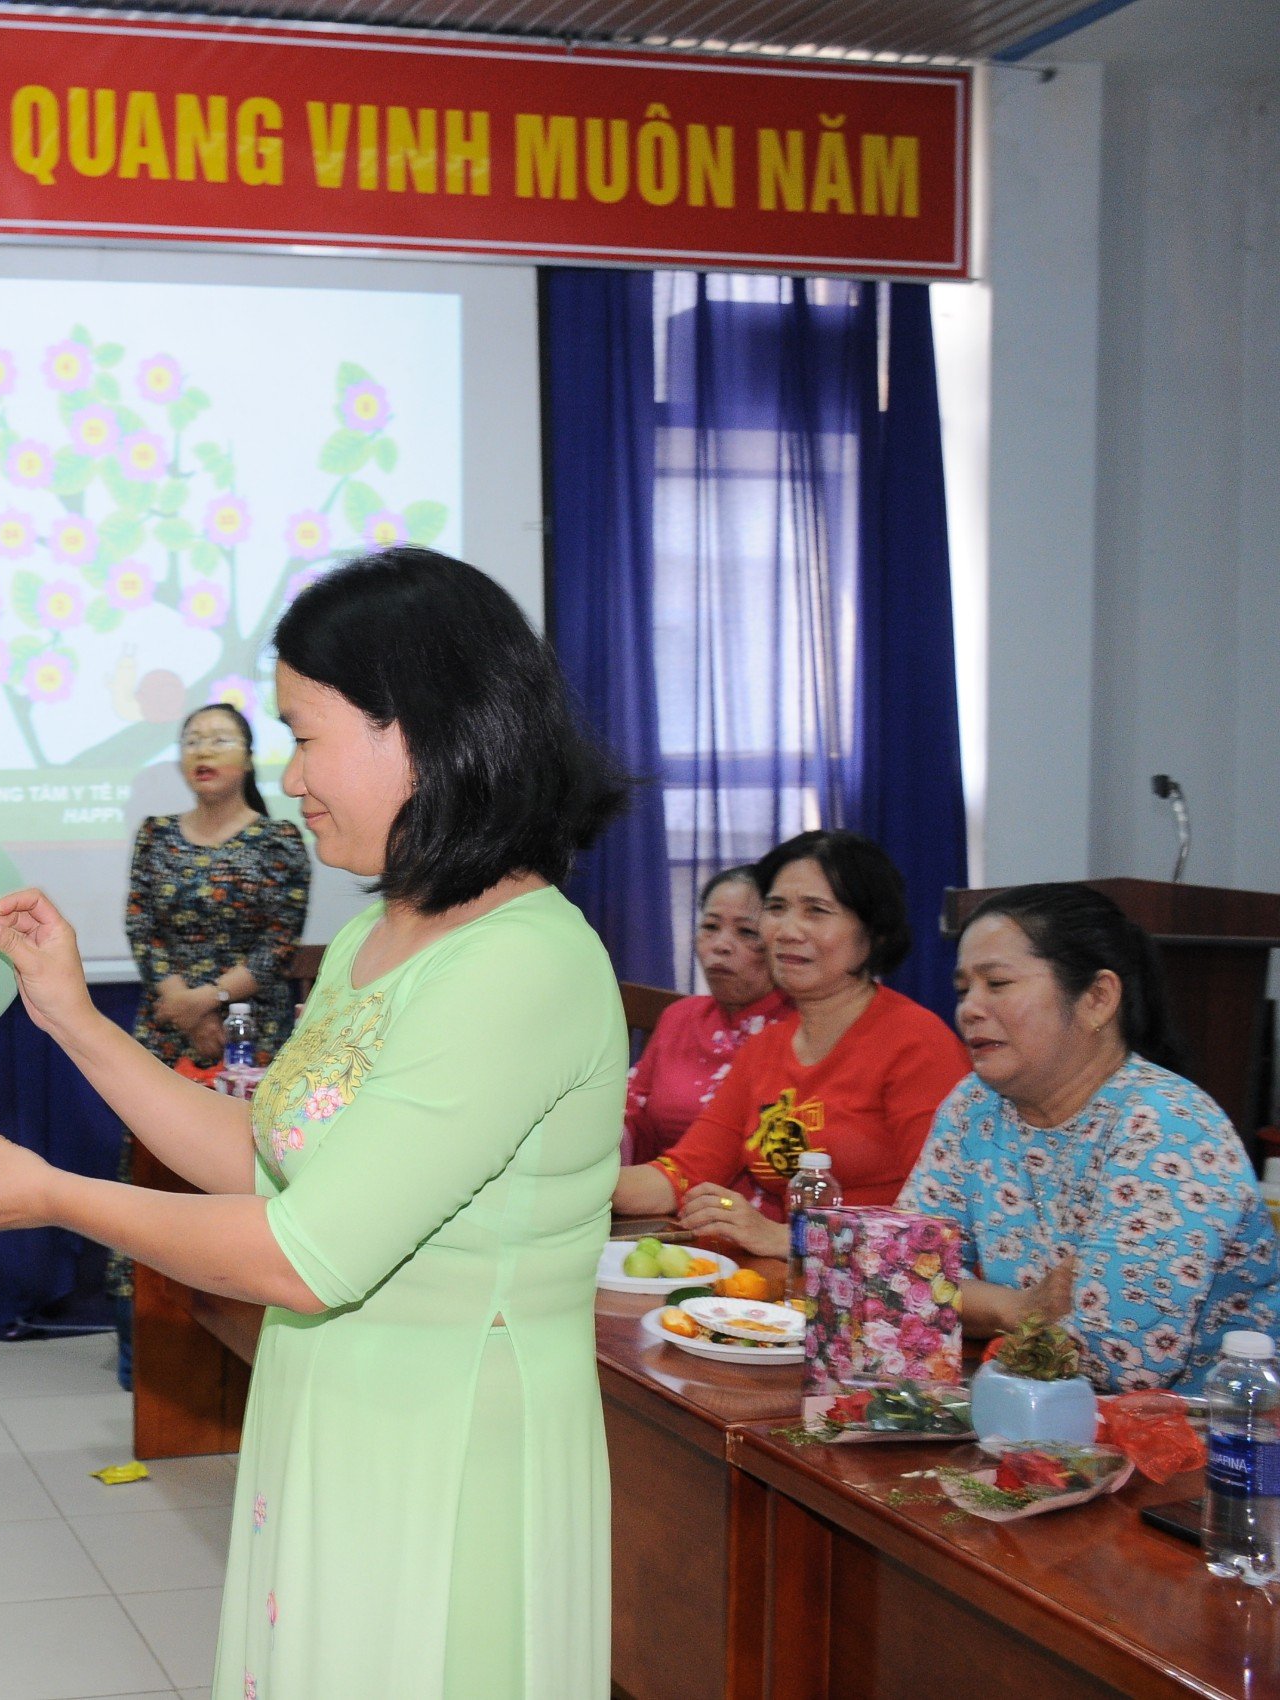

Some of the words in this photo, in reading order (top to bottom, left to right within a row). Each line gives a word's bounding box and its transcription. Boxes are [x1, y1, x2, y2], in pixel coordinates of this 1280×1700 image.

[10, 84, 284, 187] QUANG
[306, 100, 491, 197] VINH
[515, 103, 734, 208] MUÔN
[758, 113, 919, 218] NĂM
[29, 783, 70, 802] TÂM
[71, 785, 86, 801] Y
